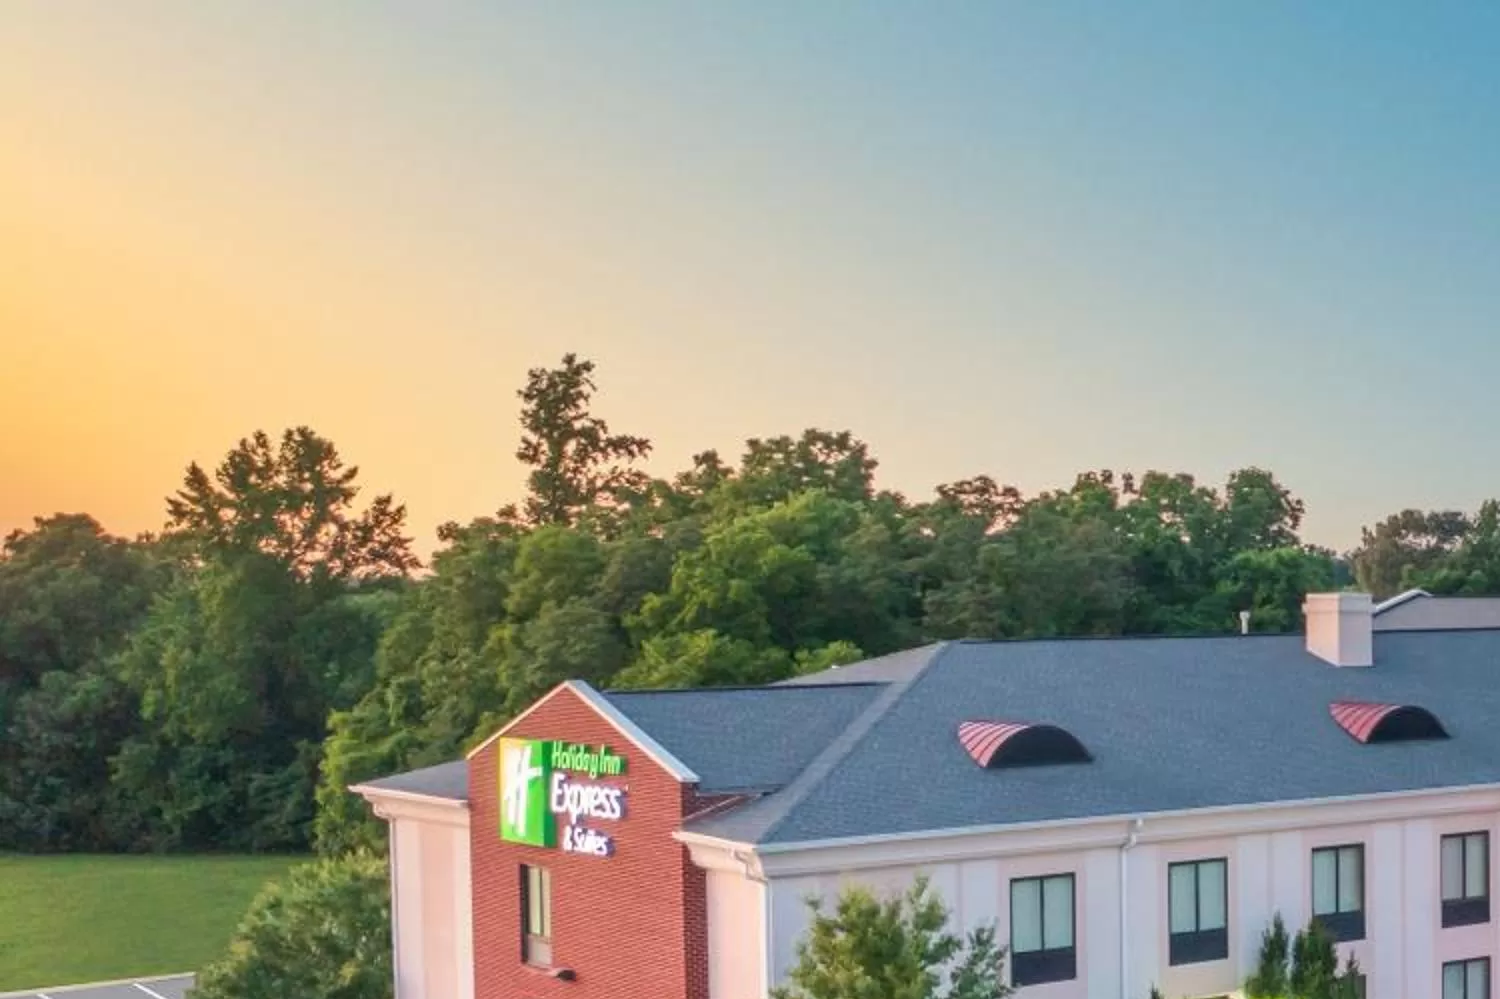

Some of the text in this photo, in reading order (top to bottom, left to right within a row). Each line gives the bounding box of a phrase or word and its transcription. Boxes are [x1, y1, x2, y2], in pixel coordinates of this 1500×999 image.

[552, 740, 622, 779] Holiday Inn
[551, 771, 622, 825] Express
[563, 825, 608, 856] & Suites
